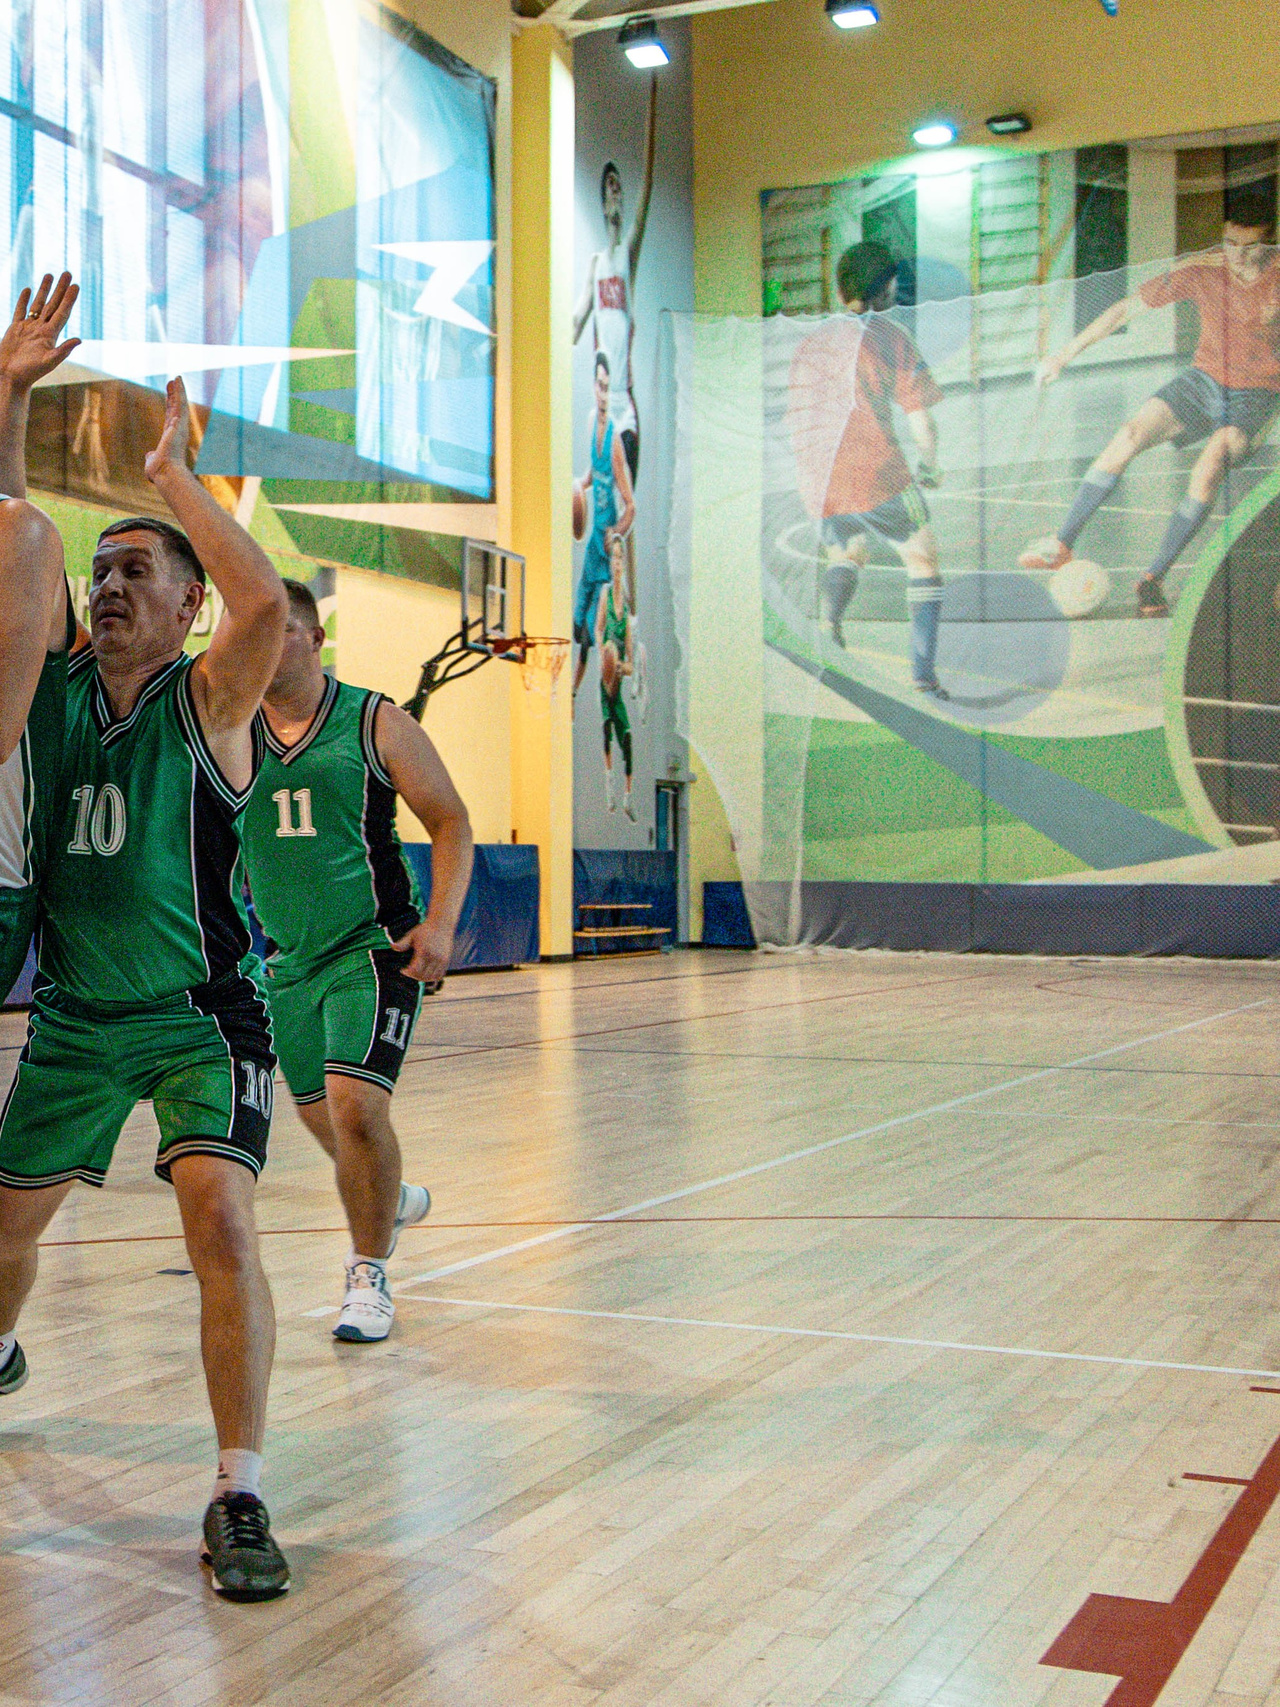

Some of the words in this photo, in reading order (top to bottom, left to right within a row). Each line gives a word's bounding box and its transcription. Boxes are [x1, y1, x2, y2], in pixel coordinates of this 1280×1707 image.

[67, 783, 127, 857] 10
[272, 788, 317, 838] 11
[380, 1007, 410, 1050] 11
[241, 1060, 272, 1120] 10
